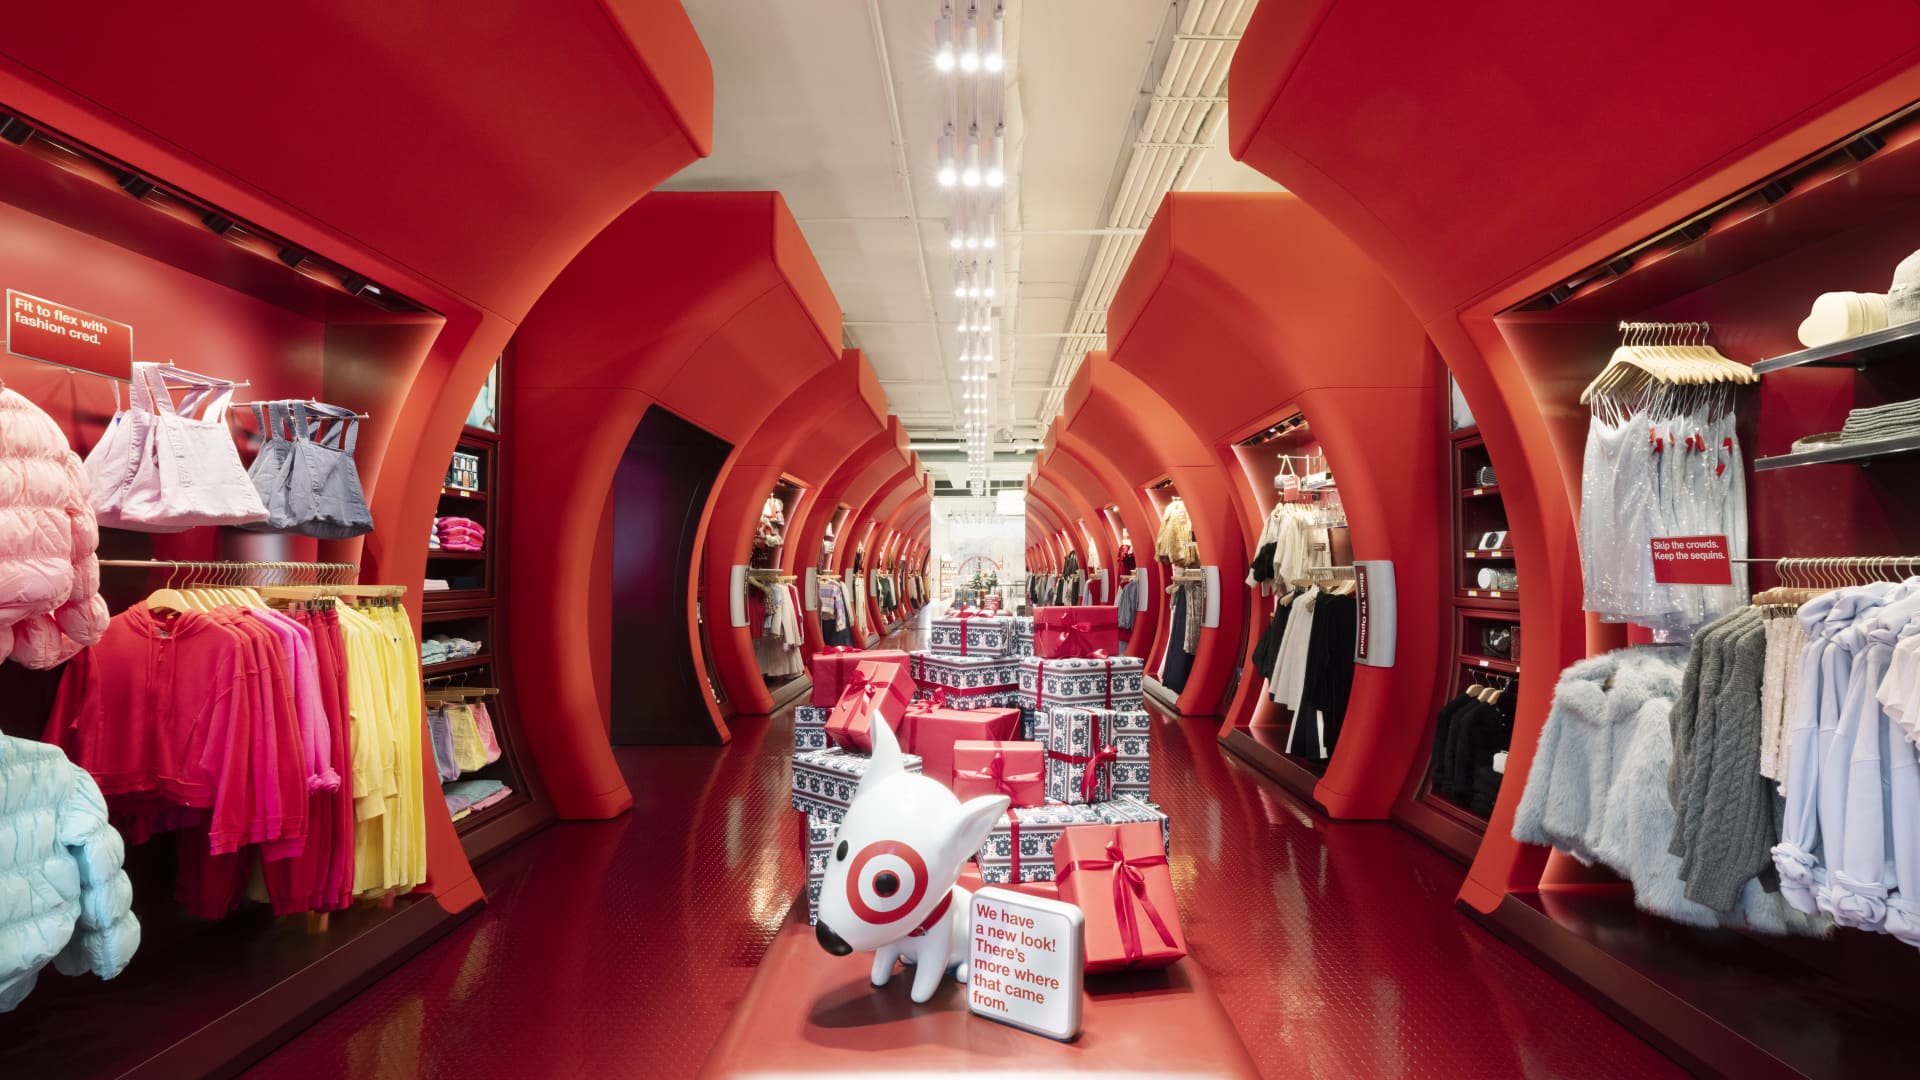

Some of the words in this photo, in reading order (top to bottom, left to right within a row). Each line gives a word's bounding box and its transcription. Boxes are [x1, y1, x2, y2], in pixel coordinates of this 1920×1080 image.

[15, 297, 33, 313] Fit
[36, 304, 51, 318] to
[54, 309, 78, 326] flex
[81, 319, 108, 335] with
[15, 311, 66, 335] fashion
[69, 329, 101, 345] cred.
[1653, 541, 1670, 551] Skip
[1672, 540, 1685, 549] the
[1686, 540, 1719, 549] crowds.
[1654, 552, 1674, 561] Keep
[1676, 551, 1688, 560] the
[1690, 551, 1726, 561] sequins.
[976, 903, 997, 920] We
[1001, 909, 1034, 929] have
[975, 923, 984, 935] a
[987, 926, 1017, 943] new
[1021, 931, 1056, 952] look!
[975, 938, 1025, 963] There’s
[974, 958, 1010, 977] more
[1014, 968, 1059, 990] where
[973, 973, 1001, 992] that
[1004, 984, 1045, 1004] came
[973, 991, 1009, 1012] from.
